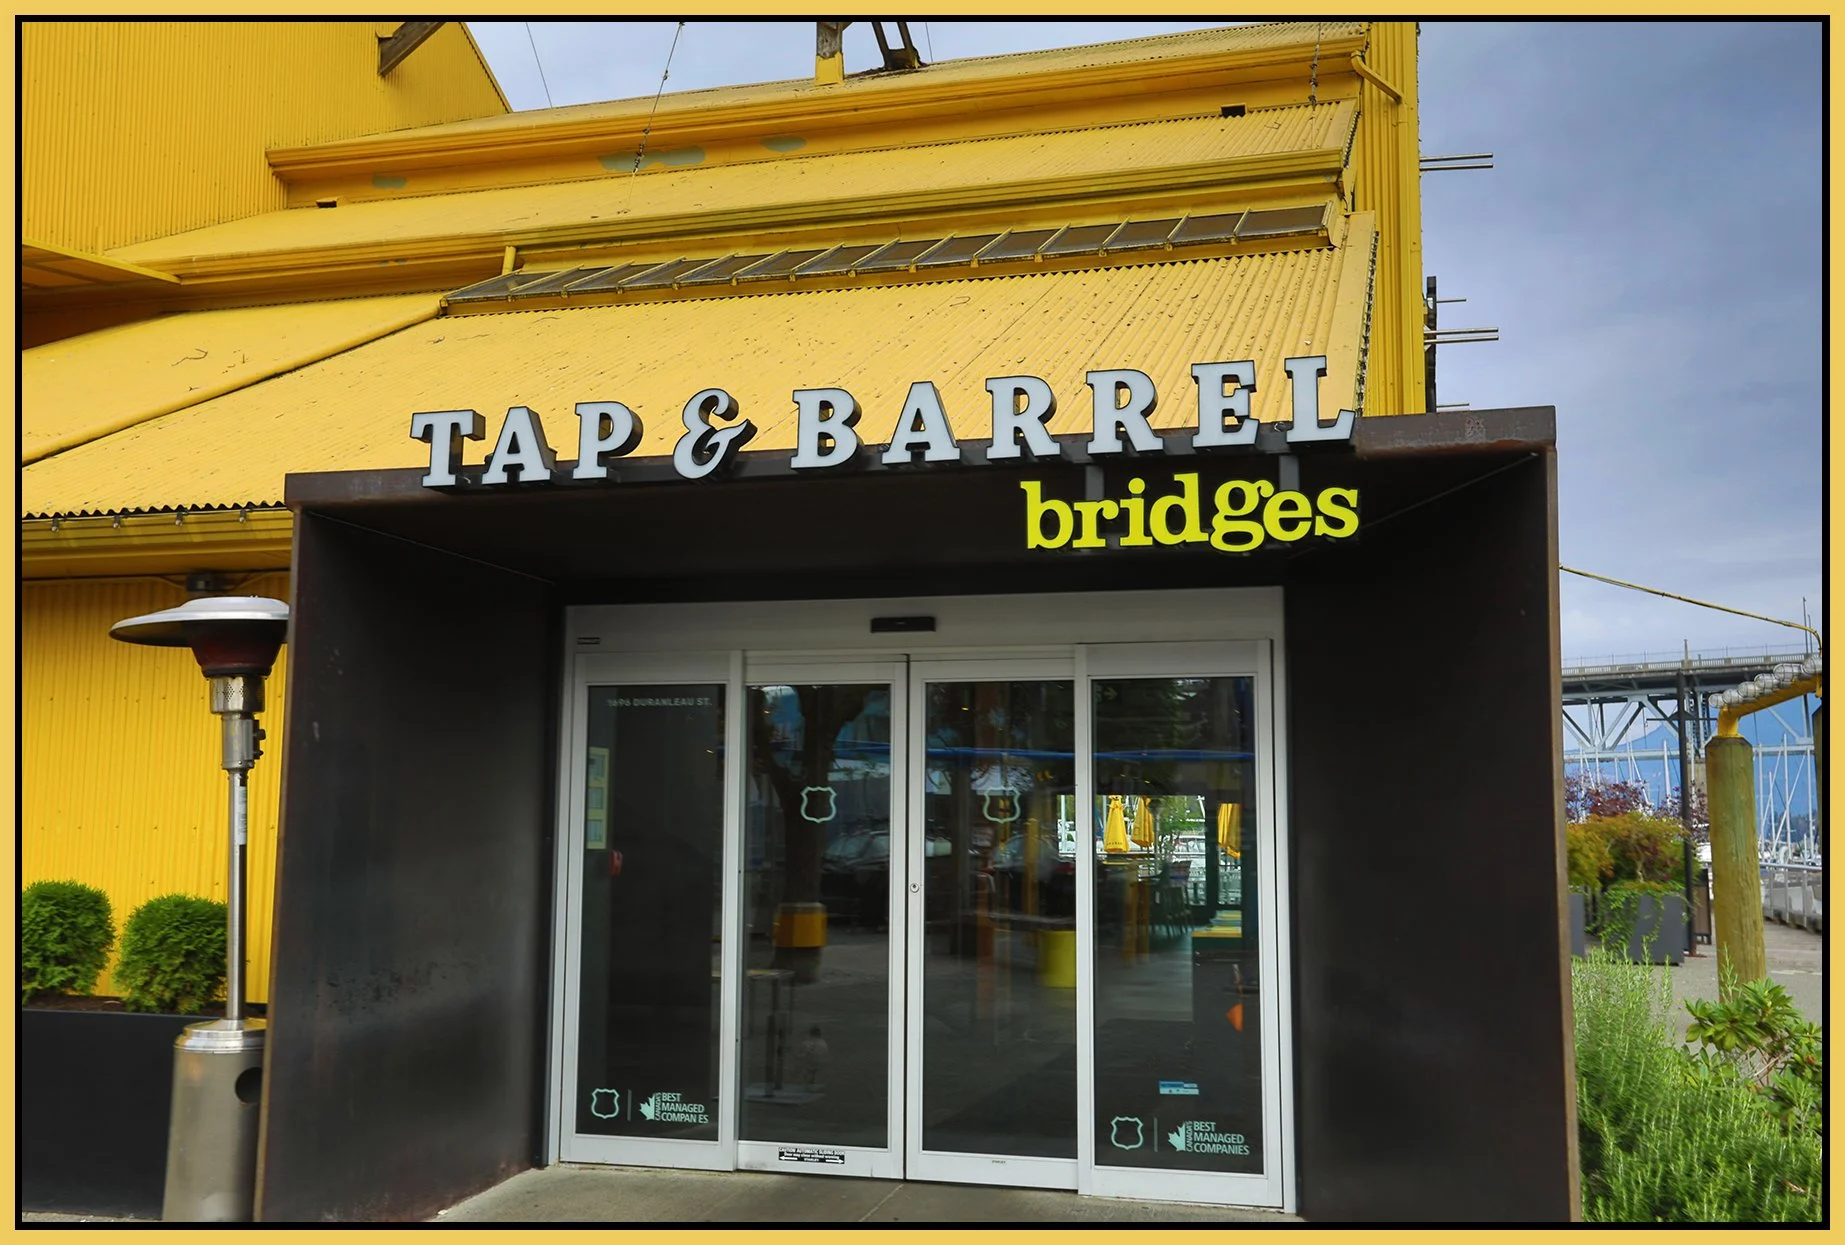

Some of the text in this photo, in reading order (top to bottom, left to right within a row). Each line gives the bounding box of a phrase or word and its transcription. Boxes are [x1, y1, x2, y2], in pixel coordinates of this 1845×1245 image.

[411, 355, 1356, 487] TAP & BARREL
[1020, 472, 1359, 552] bridges
[633, 697, 694, 707] DURANLEAU
[697, 697, 713, 706] ST.
[662, 1092, 682, 1102] BEST
[661, 1102, 705, 1113] MANAGED
[1193, 1121, 1216, 1132] BEST
[1193, 1132, 1245, 1144] MANAGED
[1193, 1143, 1250, 1156] COMPANIES
